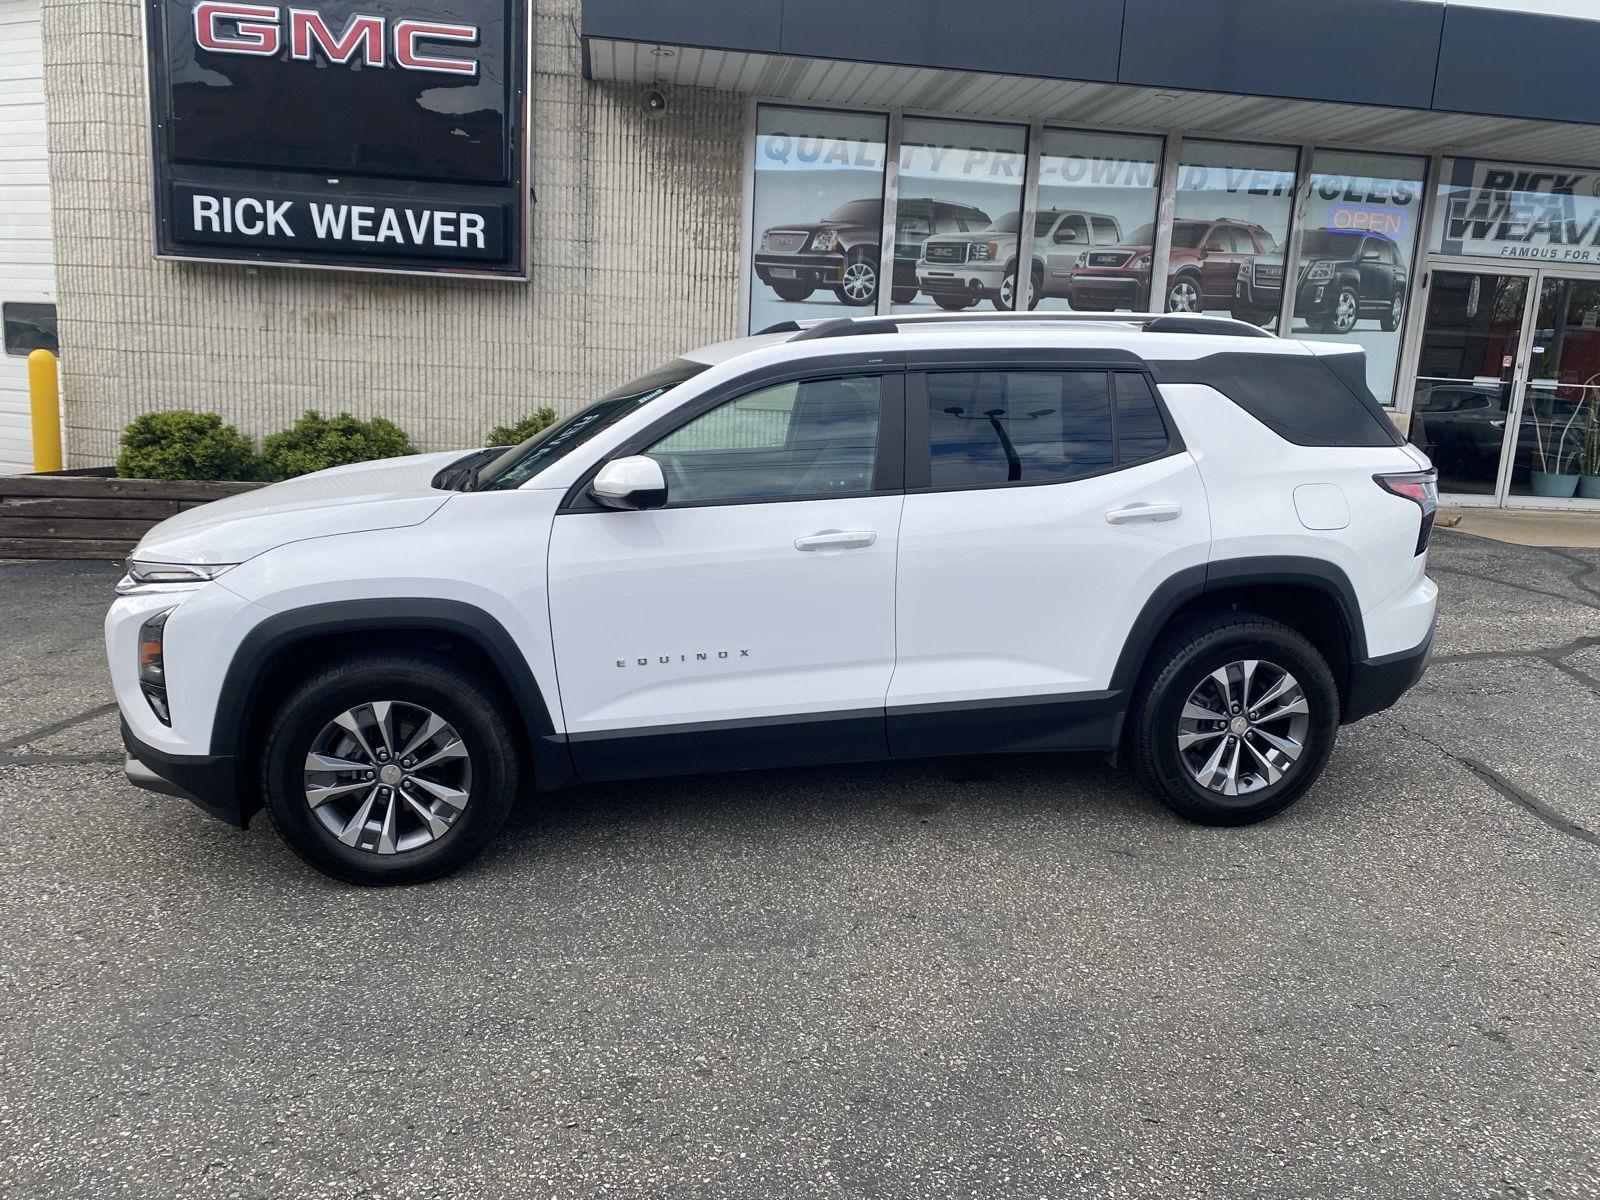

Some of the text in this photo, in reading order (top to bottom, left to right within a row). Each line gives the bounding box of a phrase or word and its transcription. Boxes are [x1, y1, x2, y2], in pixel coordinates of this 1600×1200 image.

[194, 1, 480, 76] GMC
[764, 131, 954, 172] QUALTY
[1477, 168, 1587, 201] RICK
[192, 194, 486, 249] RICK WEAVER
[1333, 208, 1402, 234] OPEN
[1500, 246, 1558, 259] FAMOUS
[1564, 249, 1590, 260] FOR
[616, 649, 749, 668] EQUINOX
